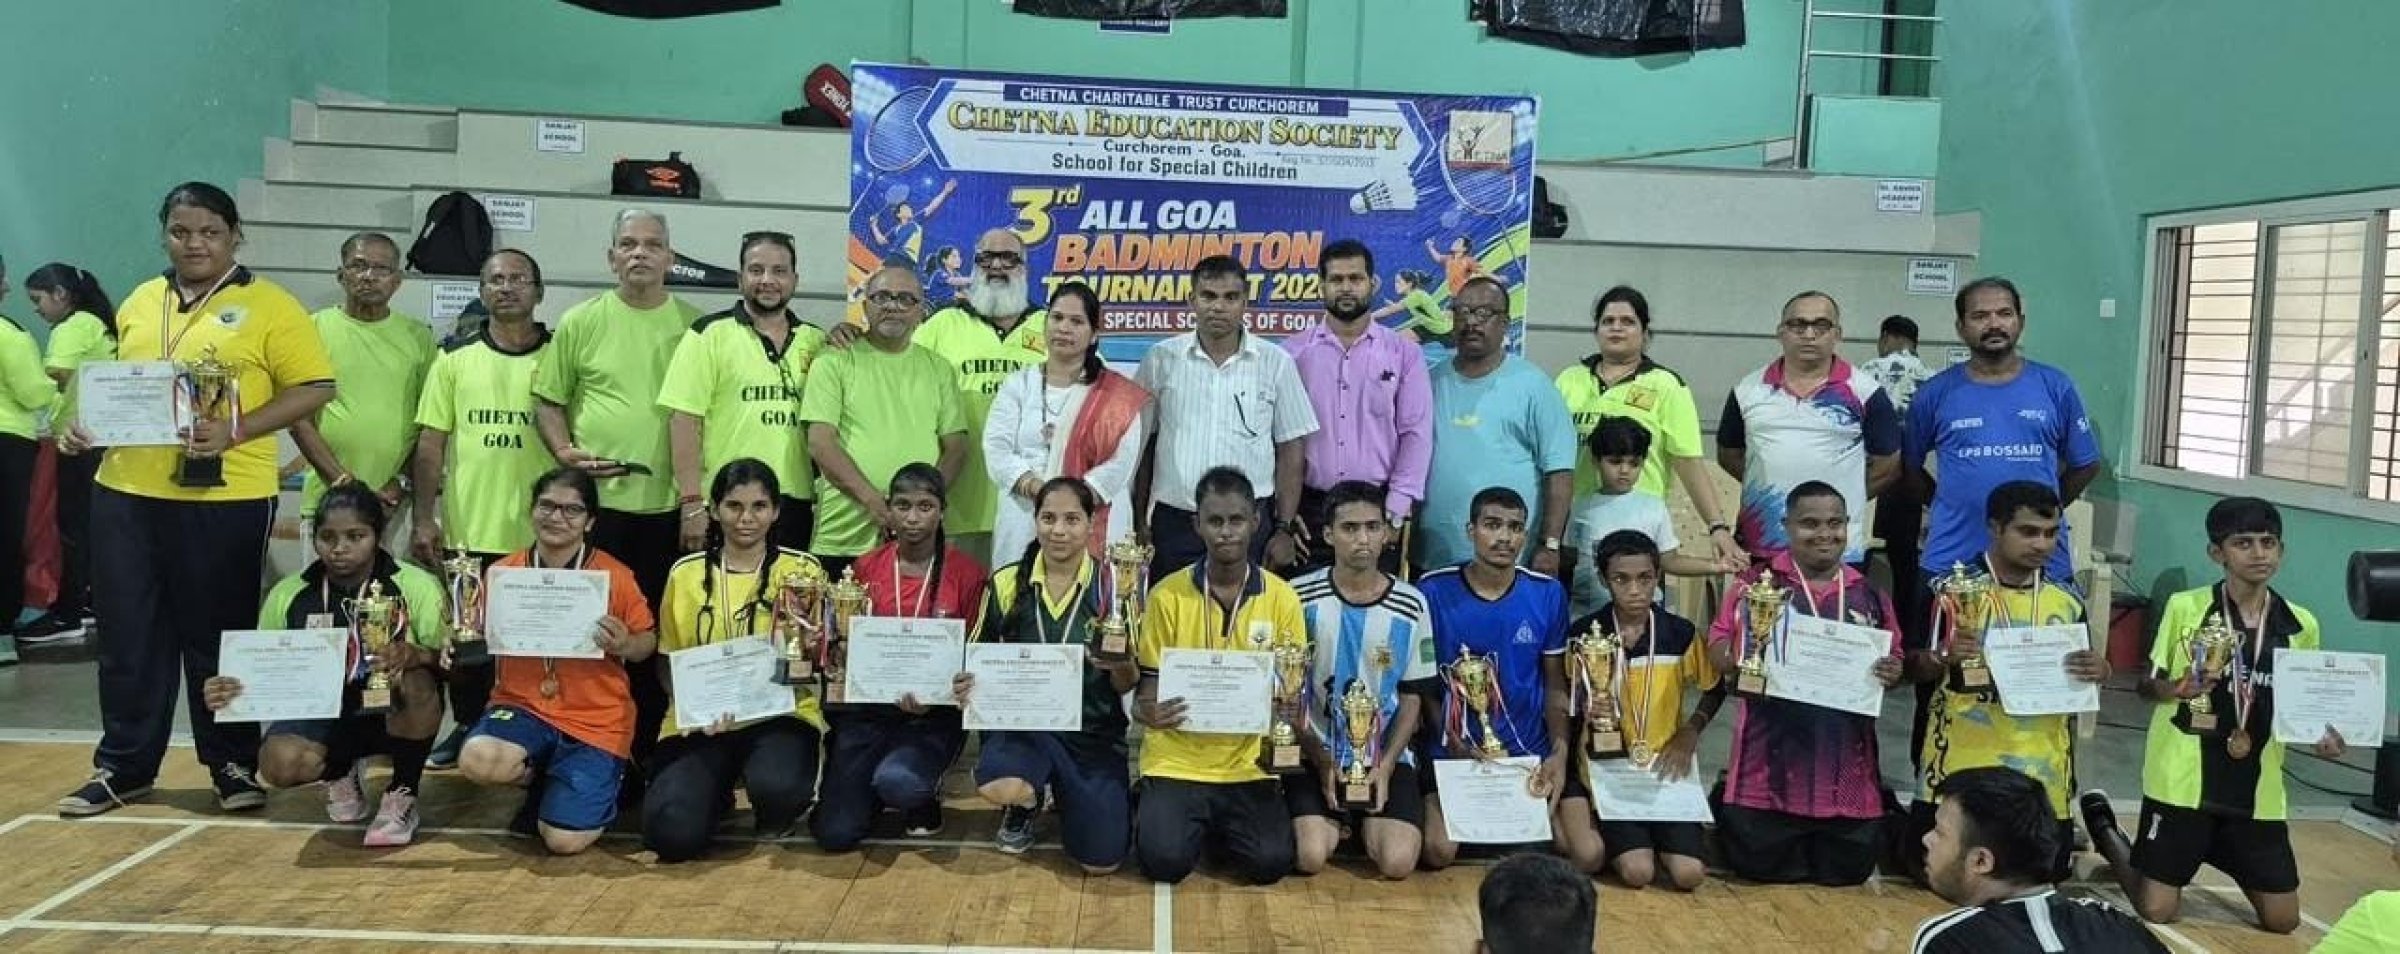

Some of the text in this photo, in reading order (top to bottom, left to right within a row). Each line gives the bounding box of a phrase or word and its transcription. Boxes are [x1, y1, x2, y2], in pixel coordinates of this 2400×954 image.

[1019, 87, 1319, 115] CHETNA CHARITABLE TRUST CURCHOREM
[1103, 138, 1192, 156] Curchorem
[1211, 143, 1246, 158] Goa.
[1051, 152, 1113, 171] School
[1120, 155, 1144, 172] for
[1150, 156, 1216, 177] Special
[1223, 160, 1297, 180] Children
[1079, 200, 1237, 230] ALL GOA
[1054, 231, 1323, 272] BADMINTON
[1270, 273, 1324, 300] 202
[1103, 311, 1172, 330] SPECIAL
[1257, 312, 1279, 330] OF
[962, 358, 1022, 375] CHETN
[468, 409, 533, 425] CHETN
[761, 409, 798, 427] GOA
[483, 432, 524, 449] GOA
